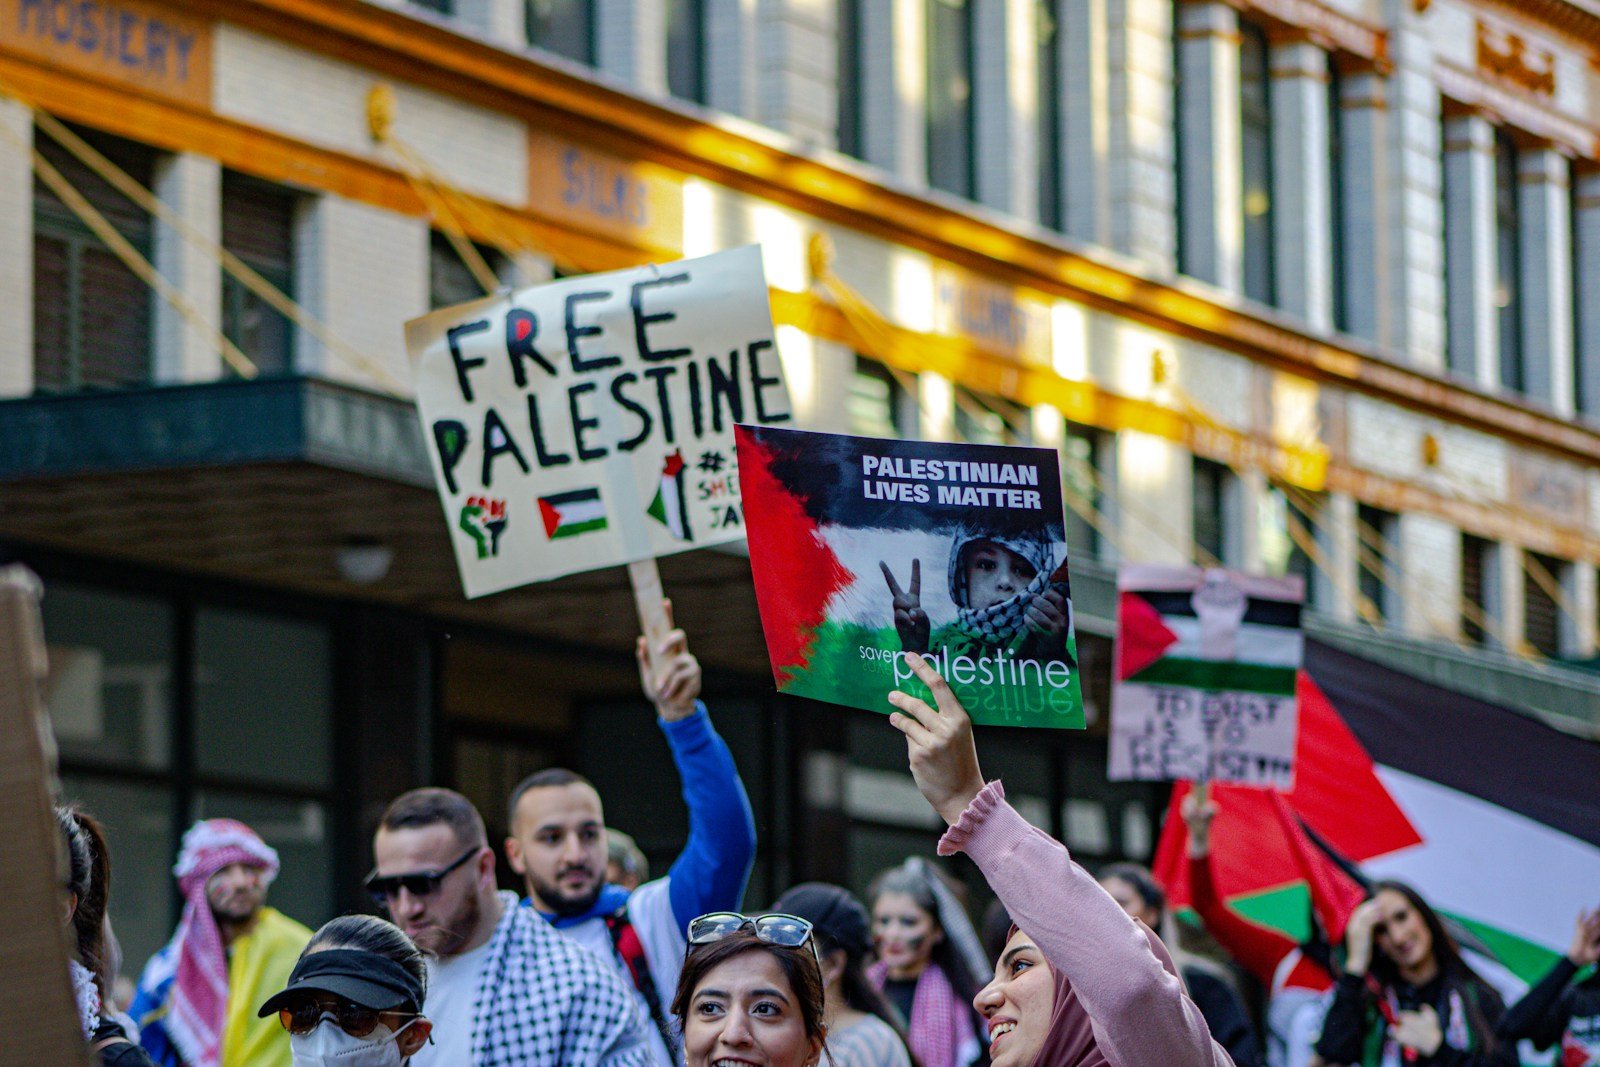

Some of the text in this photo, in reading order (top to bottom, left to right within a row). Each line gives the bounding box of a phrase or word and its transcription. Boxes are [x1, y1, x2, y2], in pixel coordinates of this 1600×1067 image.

[447, 272, 693, 401] FREE
[432, 340, 791, 494] PALESTINE
[862, 455, 1038, 486] PALESTINIAN
[863, 480, 1042, 509] LIVES MATTER
